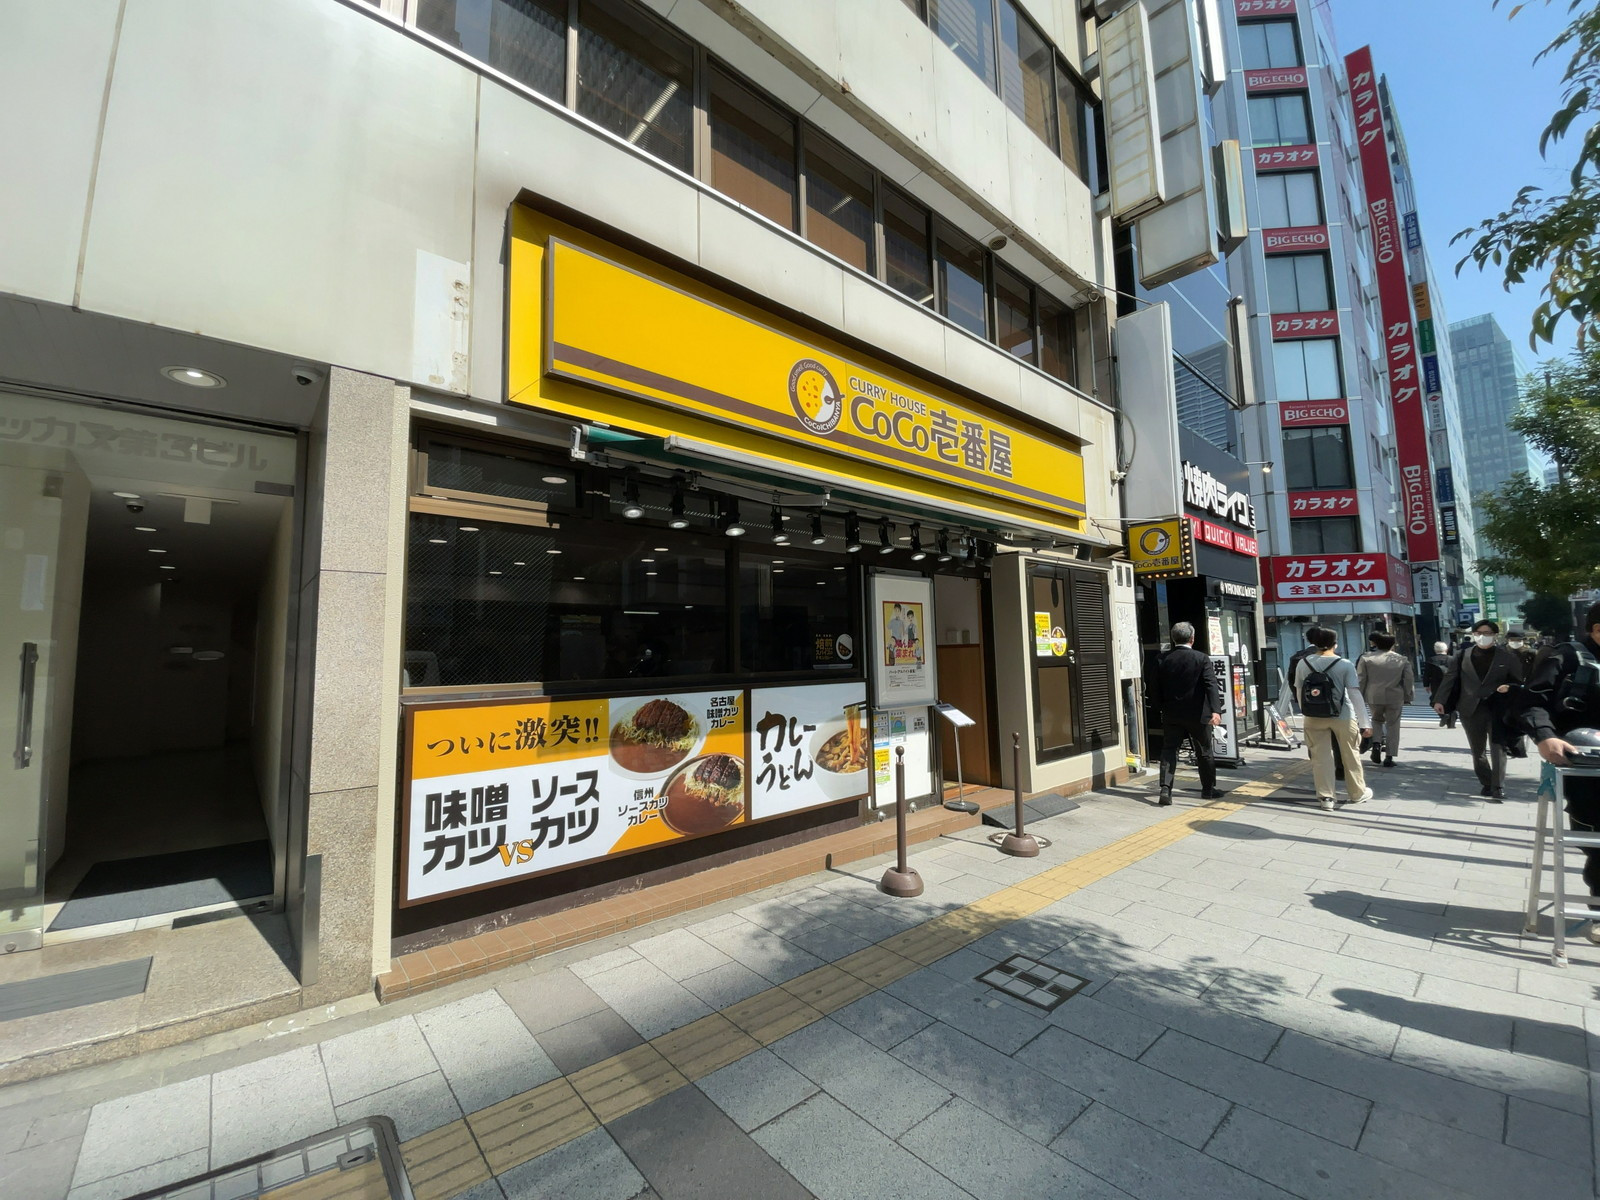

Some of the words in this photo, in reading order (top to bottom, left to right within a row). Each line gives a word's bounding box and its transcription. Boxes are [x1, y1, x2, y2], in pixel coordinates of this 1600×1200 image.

[1249, 76, 1271, 87] BIG
[1272, 73, 1304, 83] ECHO
[1353, 71, 1381, 146] カラオケ
[1258, 150, 1314, 164] カラオケ
[1371, 198, 1388, 226] BIG
[1267, 236, 1290, 247] BIG
[1291, 233, 1326, 244] ECHO
[1378, 225, 1395, 264] ECHO
[1276, 317, 1334, 332] カラオケ
[1388, 321, 1417, 403] カラオケ
[849, 377, 887, 401] CURRY
[890, 392, 927, 416] HOUSE
[1284, 408, 1309, 421] BIG
[1310, 408, 1345, 419] ECHO
[850, 396, 1013, 478] CoCo壱番屋
[1403, 465, 1422, 493] BIG
[1293, 497, 1353, 511] カラオケ
[1410, 494, 1428, 535] ECHO
[1205, 524, 1232, 547] QUICK!
[1234, 535, 1258, 555] VALUE!
[1286, 558, 1375, 579] カラオケ
[1290, 583, 1375, 595] 全室DAM
[706, 707, 739, 719] 味噌カツ
[710, 695, 735, 707] 名古屋
[427, 714, 600, 757] ついに激突!!
[711, 719, 735, 728] カレー
[756, 710, 817, 753] カレー
[756, 749, 814, 794] うどん
[531, 769, 600, 815] ソース
[634, 787, 654, 801] 信州
[425, 783, 509, 832] 味噌
[618, 796, 668, 817] ソースカツ
[628, 814, 658, 826] カレー
[530, 807, 600, 851] カツ
[422, 824, 507, 876] カツ
[498, 839, 535, 868] VS
